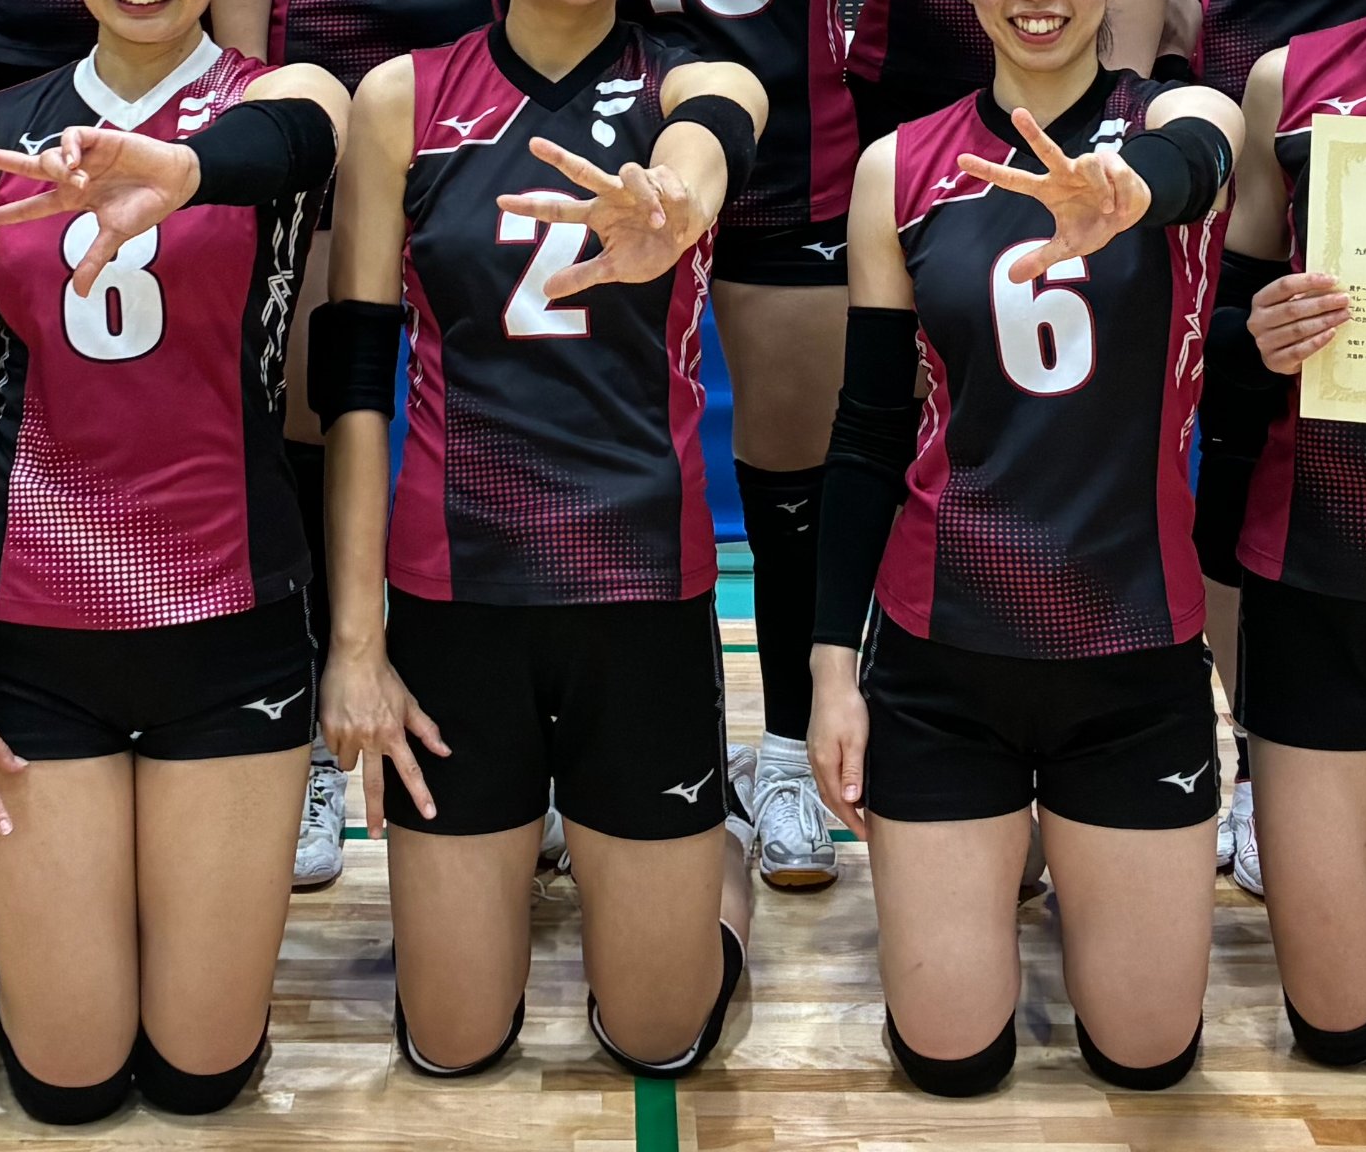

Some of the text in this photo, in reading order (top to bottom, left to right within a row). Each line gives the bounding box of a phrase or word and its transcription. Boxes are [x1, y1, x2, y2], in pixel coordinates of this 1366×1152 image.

[60, 210, 167, 364] 8
[496, 188, 591, 339] 2
[989, 238, 1097, 397] 6
